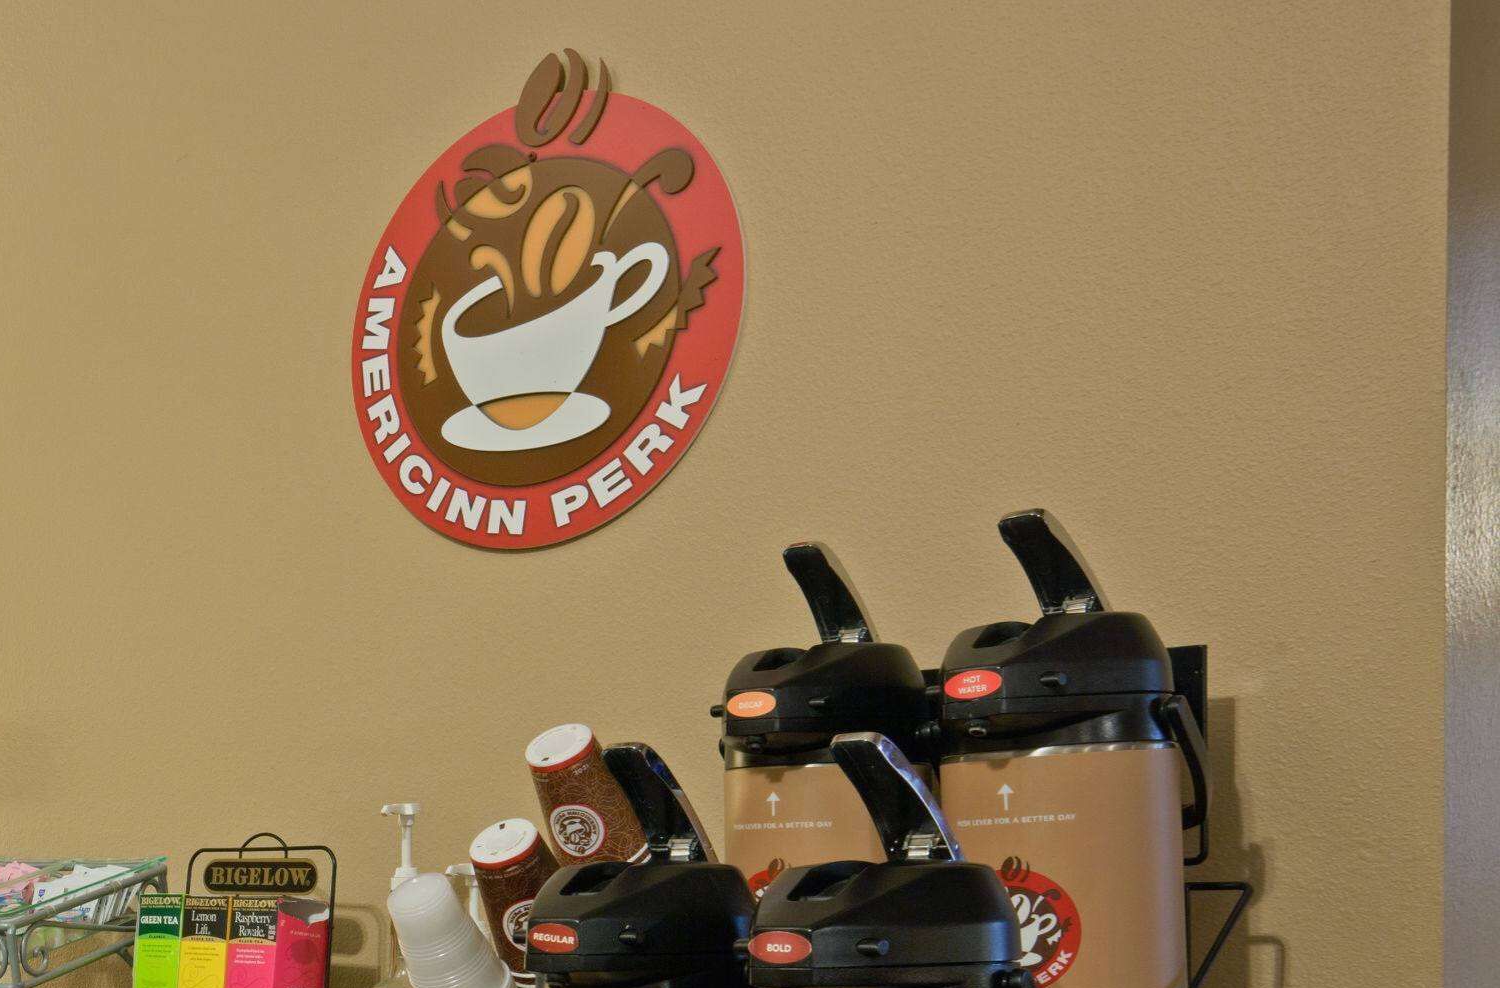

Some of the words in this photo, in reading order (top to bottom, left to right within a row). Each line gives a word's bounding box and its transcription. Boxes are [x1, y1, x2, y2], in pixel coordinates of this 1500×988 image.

[362, 246, 527, 535] AMERICINN
[551, 373, 707, 528] PERK
[963, 675, 980, 684] HOT
[957, 685, 987, 695] WATER
[785, 821, 815, 829] BETTER
[995, 817, 1011, 825] FOR
[1021, 815, 1054, 824] BETTER
[1057, 813, 1076, 822] DAY
[140, 915, 162, 925] GREEN
[163, 915, 179, 925] TEA
[191, 910, 217, 922] Lemon
[235, 911, 270, 926] Raspberry
[533, 932, 575, 945] REGULAR
[766, 943, 792, 952] BOLD
[1035, 949, 1073, 984] ERK
